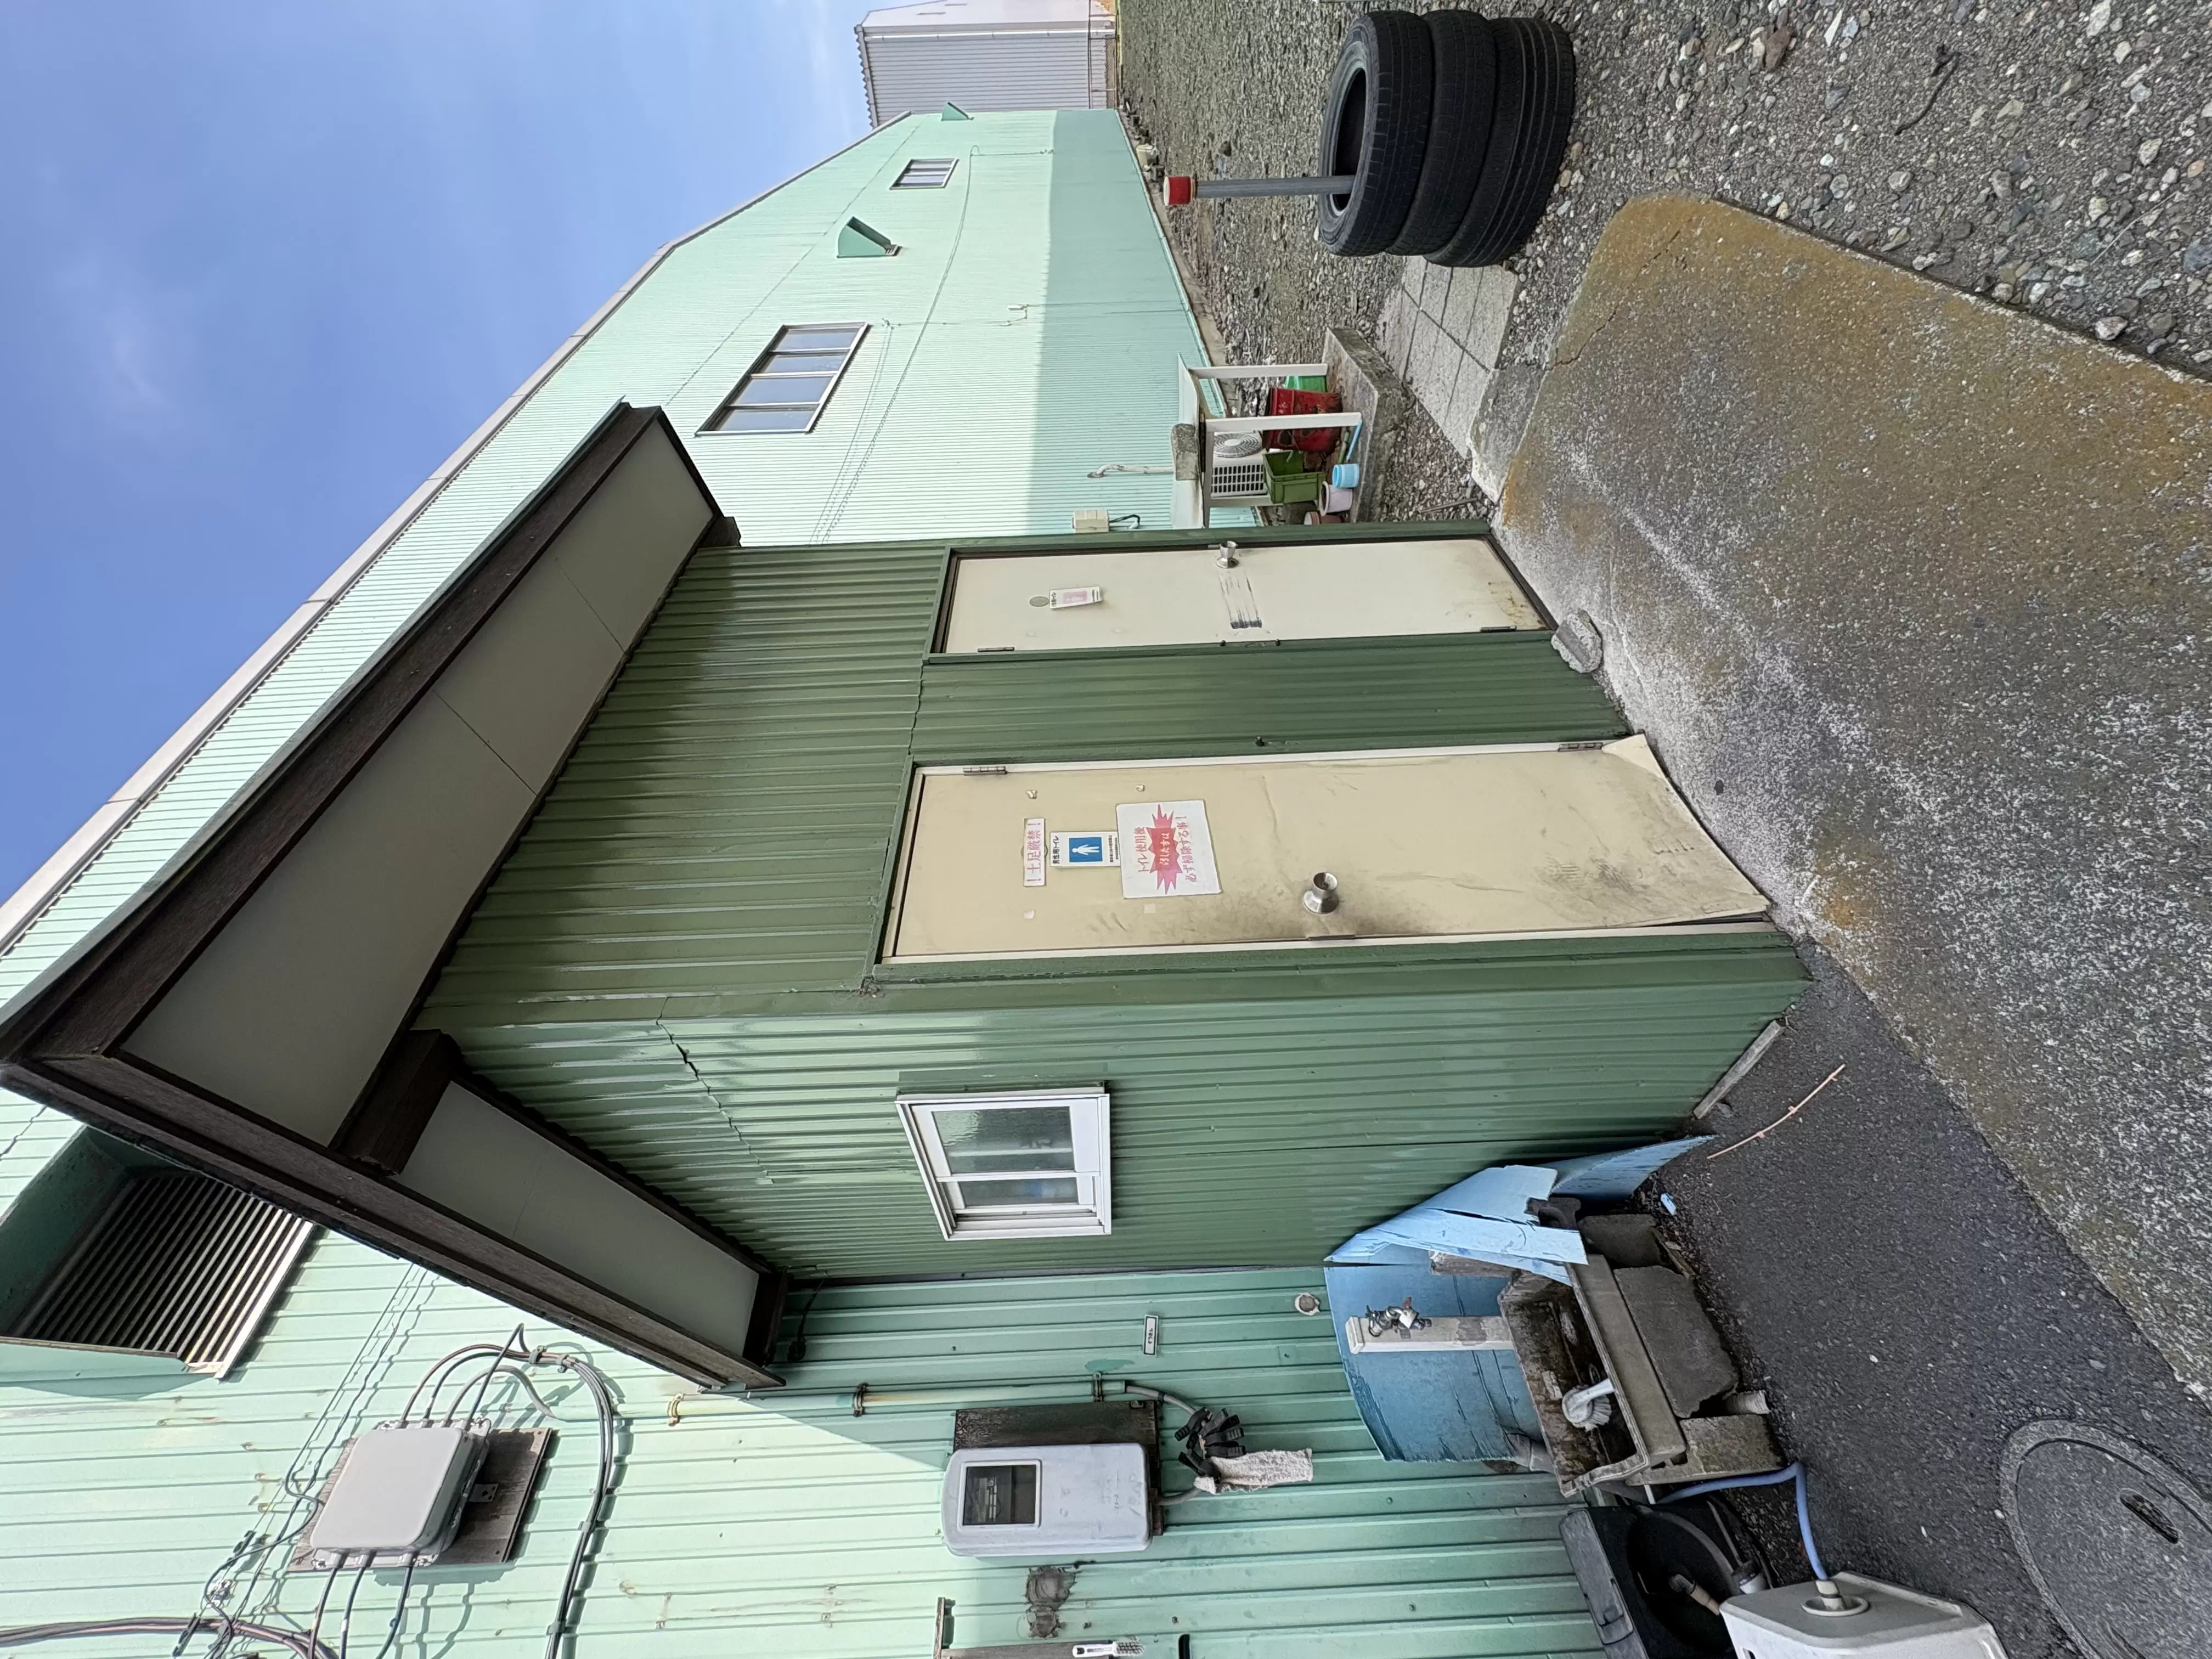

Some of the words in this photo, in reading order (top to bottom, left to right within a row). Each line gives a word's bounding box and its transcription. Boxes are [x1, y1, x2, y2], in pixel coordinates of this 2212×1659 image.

[1133, 827, 1150, 873] トイレ使用後
[1159, 832, 1170, 866] 汚した方は
